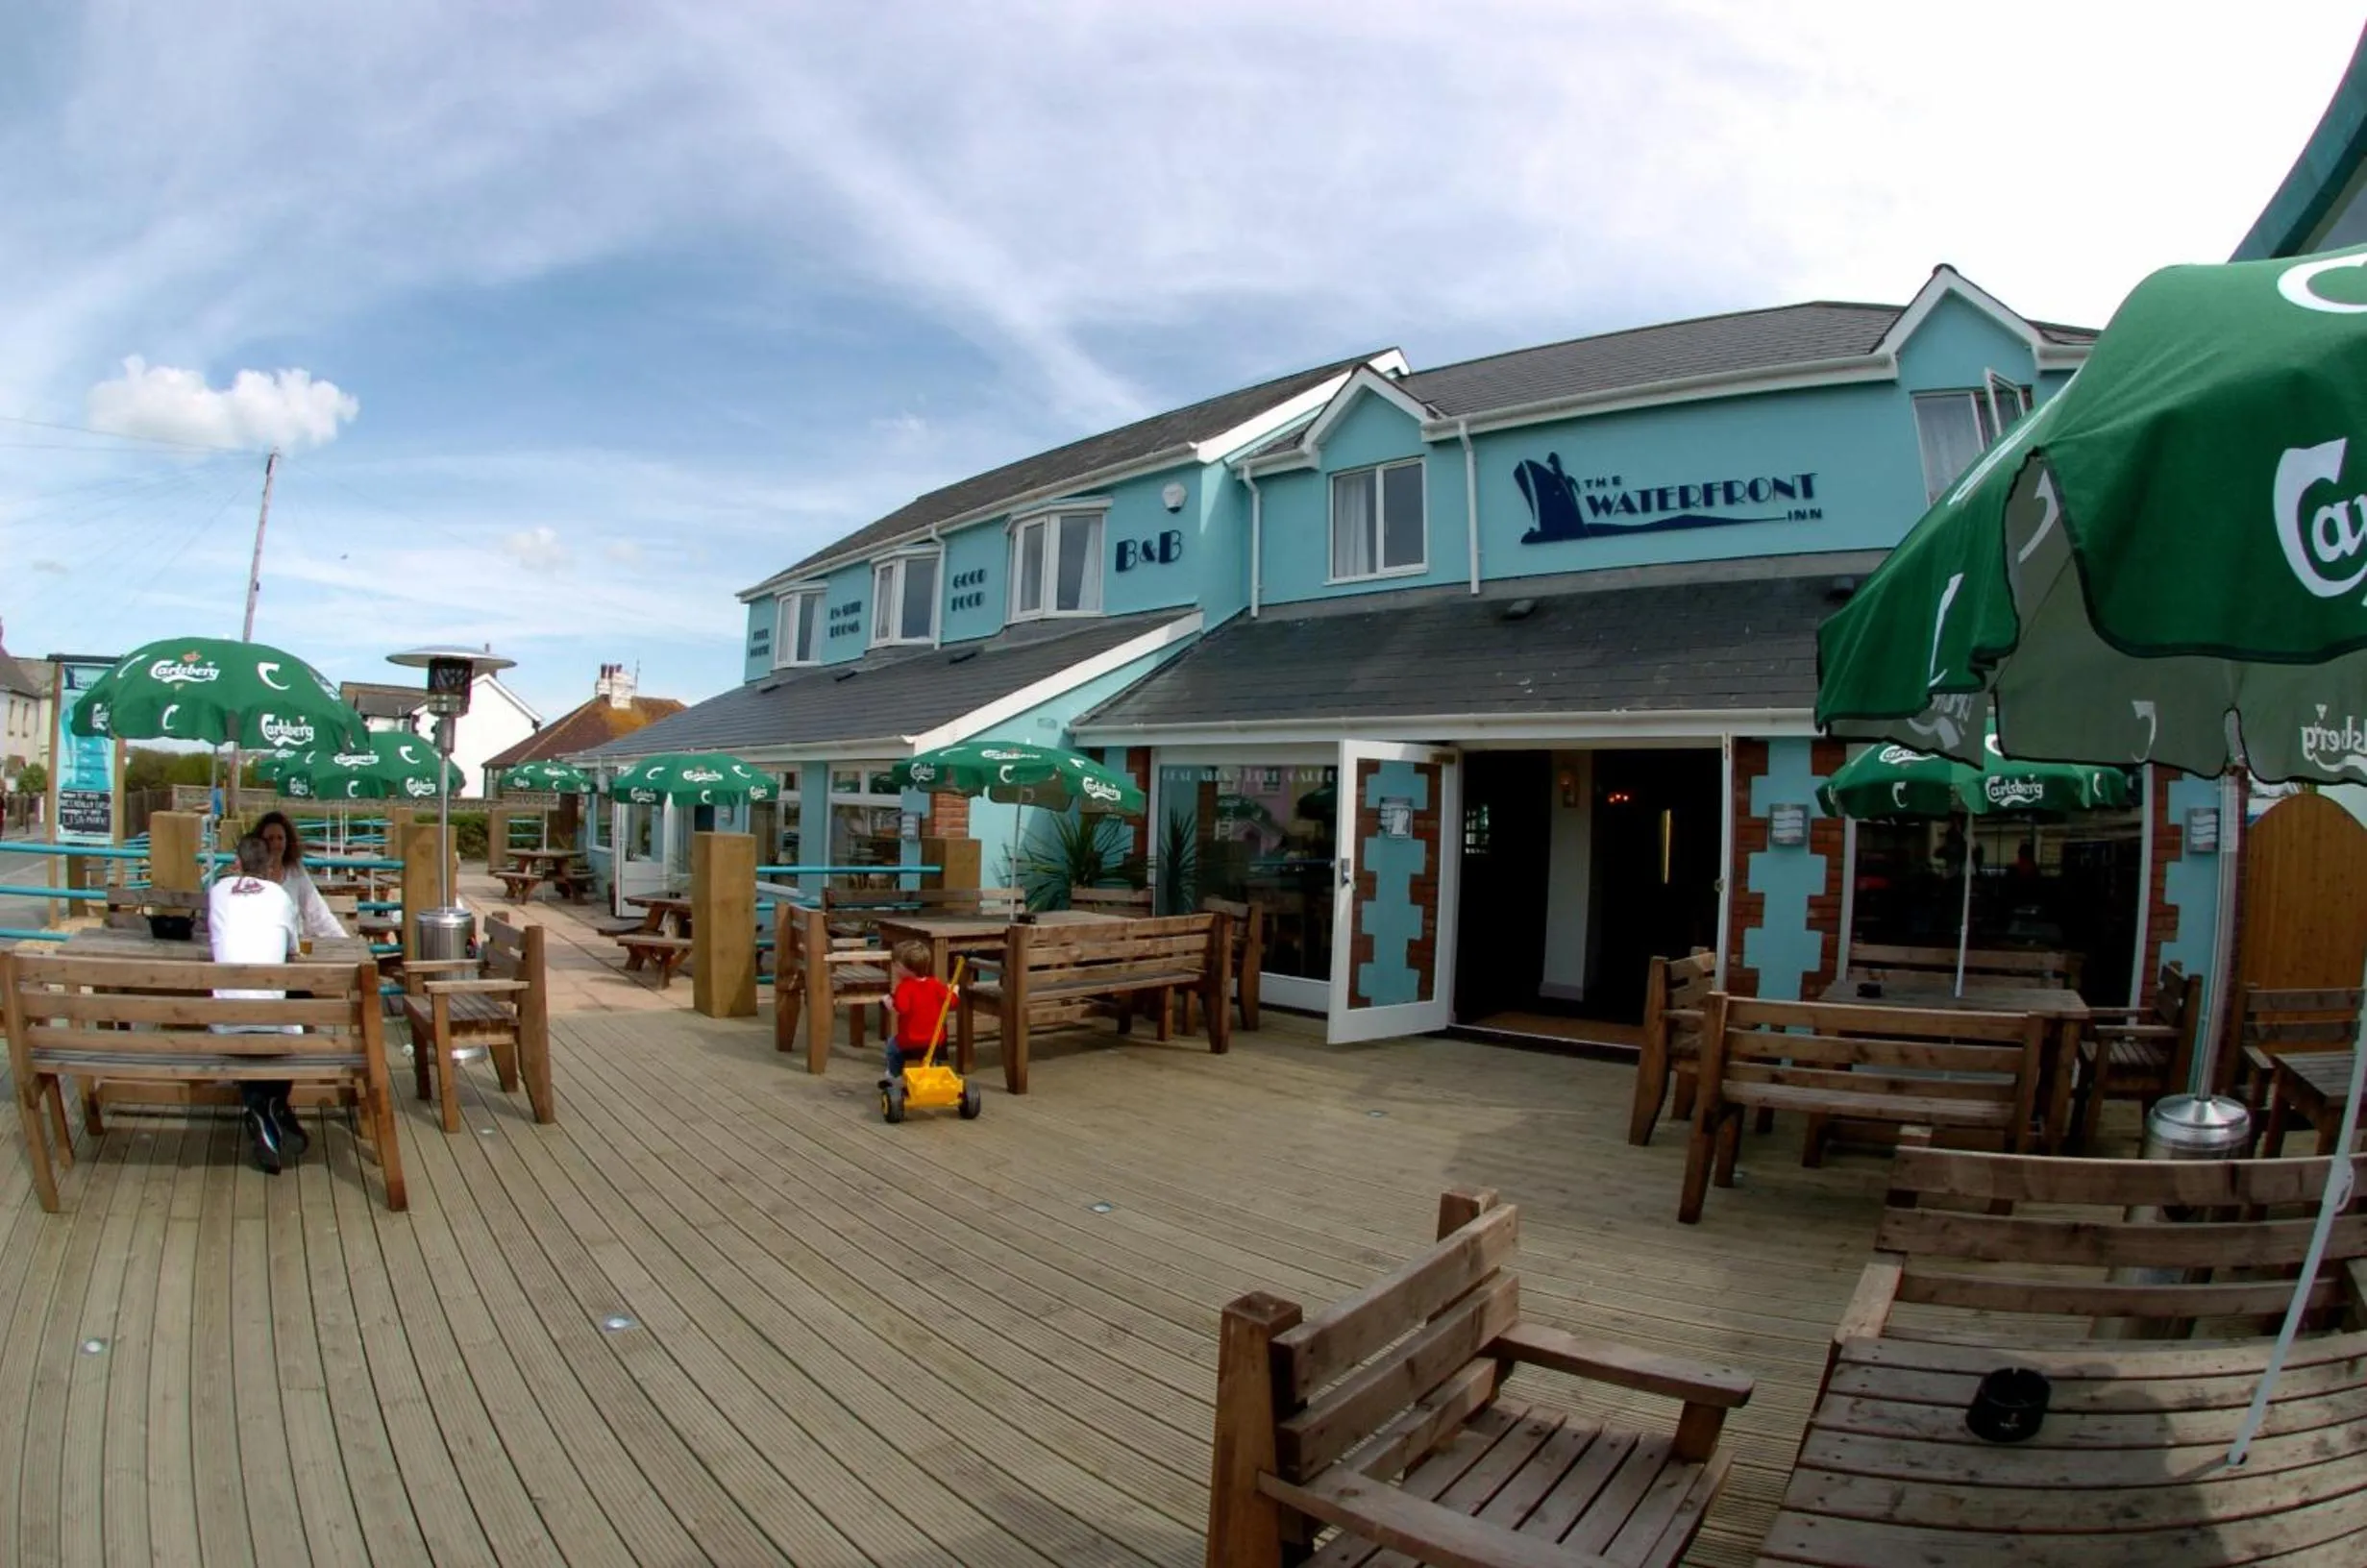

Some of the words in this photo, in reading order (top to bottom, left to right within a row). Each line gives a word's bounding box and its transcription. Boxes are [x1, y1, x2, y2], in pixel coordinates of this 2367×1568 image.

[1586, 476, 1621, 488] THE
[1586, 473, 1818, 519] WATERFRONT
[1788, 508, 1822, 521] INN
[1116, 529, 1182, 573] B&B
[953, 569, 987, 589] GOOD
[951, 591, 985, 612] FOOD
[150, 660, 220, 683] Carlsberg
[261, 714, 314, 747] Carlsberg
[1082, 776, 1122, 800] Carlsberg
[1985, 772, 2044, 807] Carlsberg
